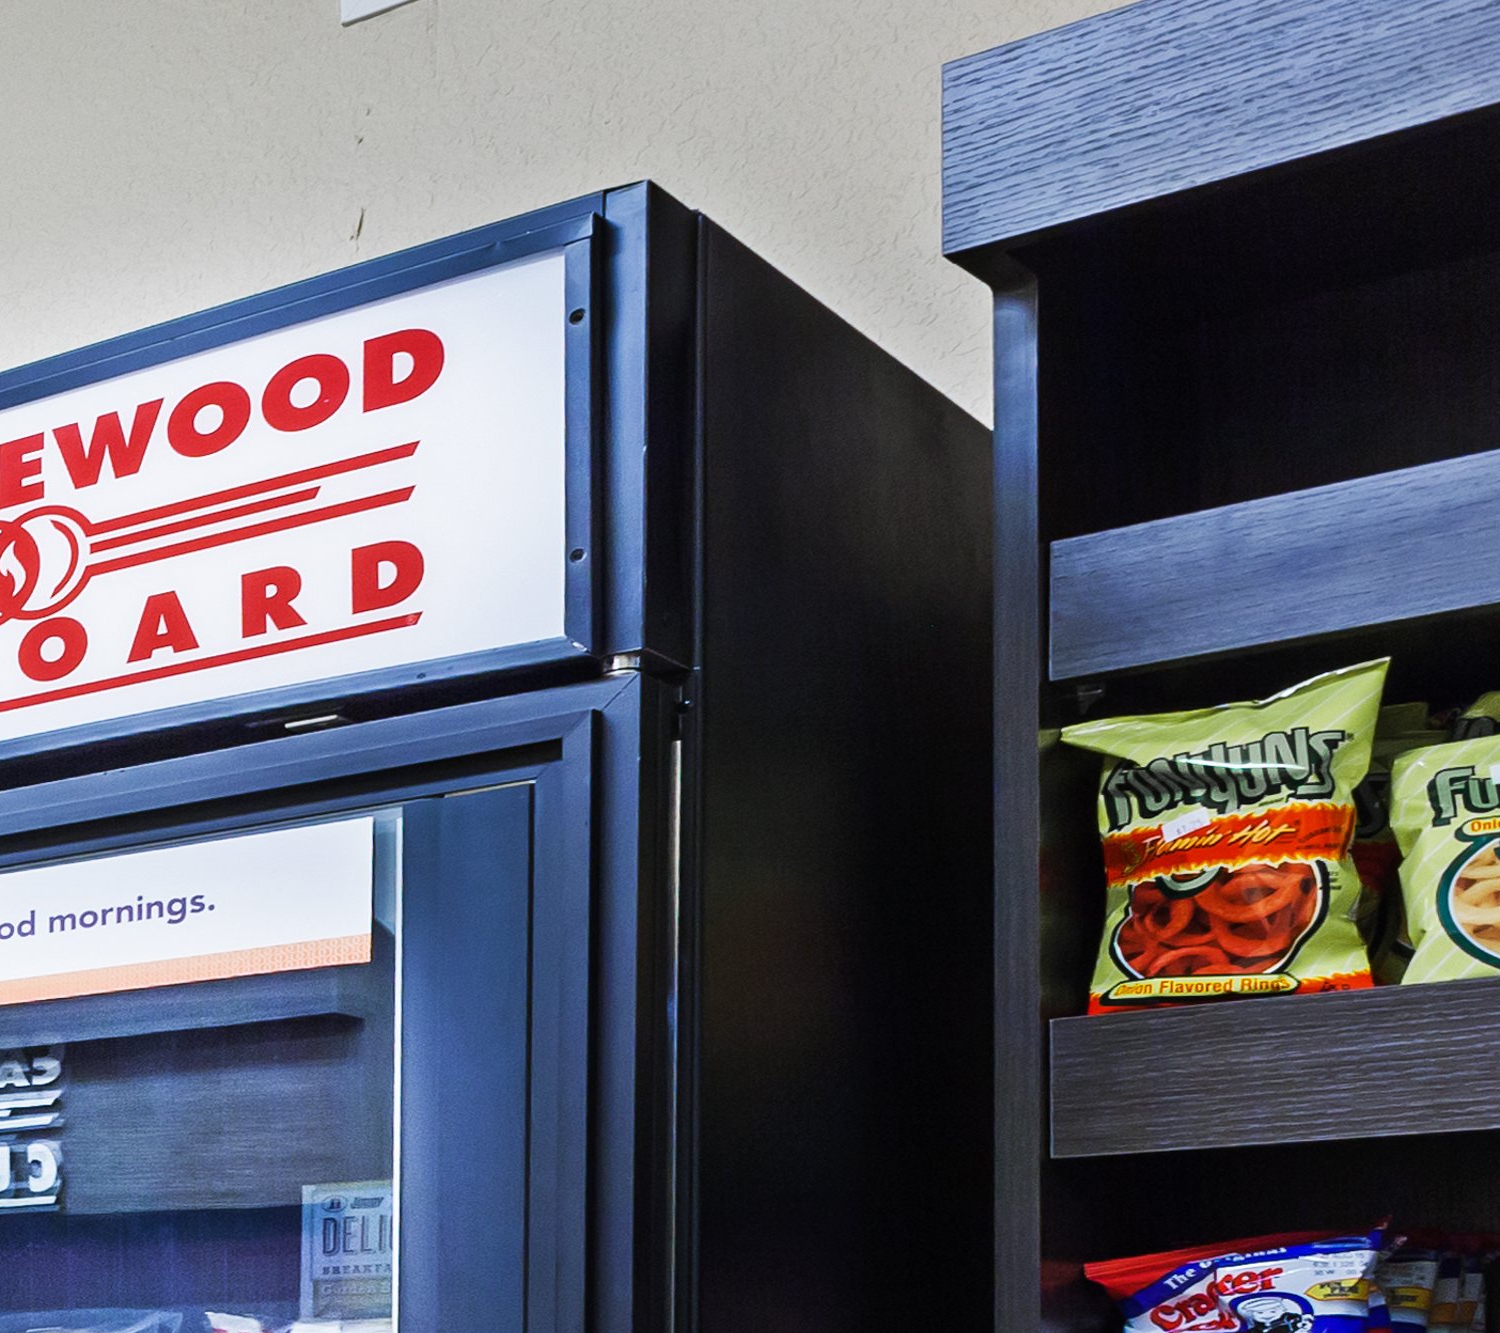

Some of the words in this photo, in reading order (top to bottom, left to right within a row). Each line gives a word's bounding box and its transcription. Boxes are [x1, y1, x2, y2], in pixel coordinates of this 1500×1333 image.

[1102, 726, 1347, 832] FUNYUNS
[1227, 820, 1296, 845] Hot
[48, 888, 216, 936] mornings.
[1113, 981, 1153, 997] Onion
[1158, 978, 1233, 996] Flavored
[1240, 976, 1292, 993] Rings
[1163, 1268, 1197, 1291] The
